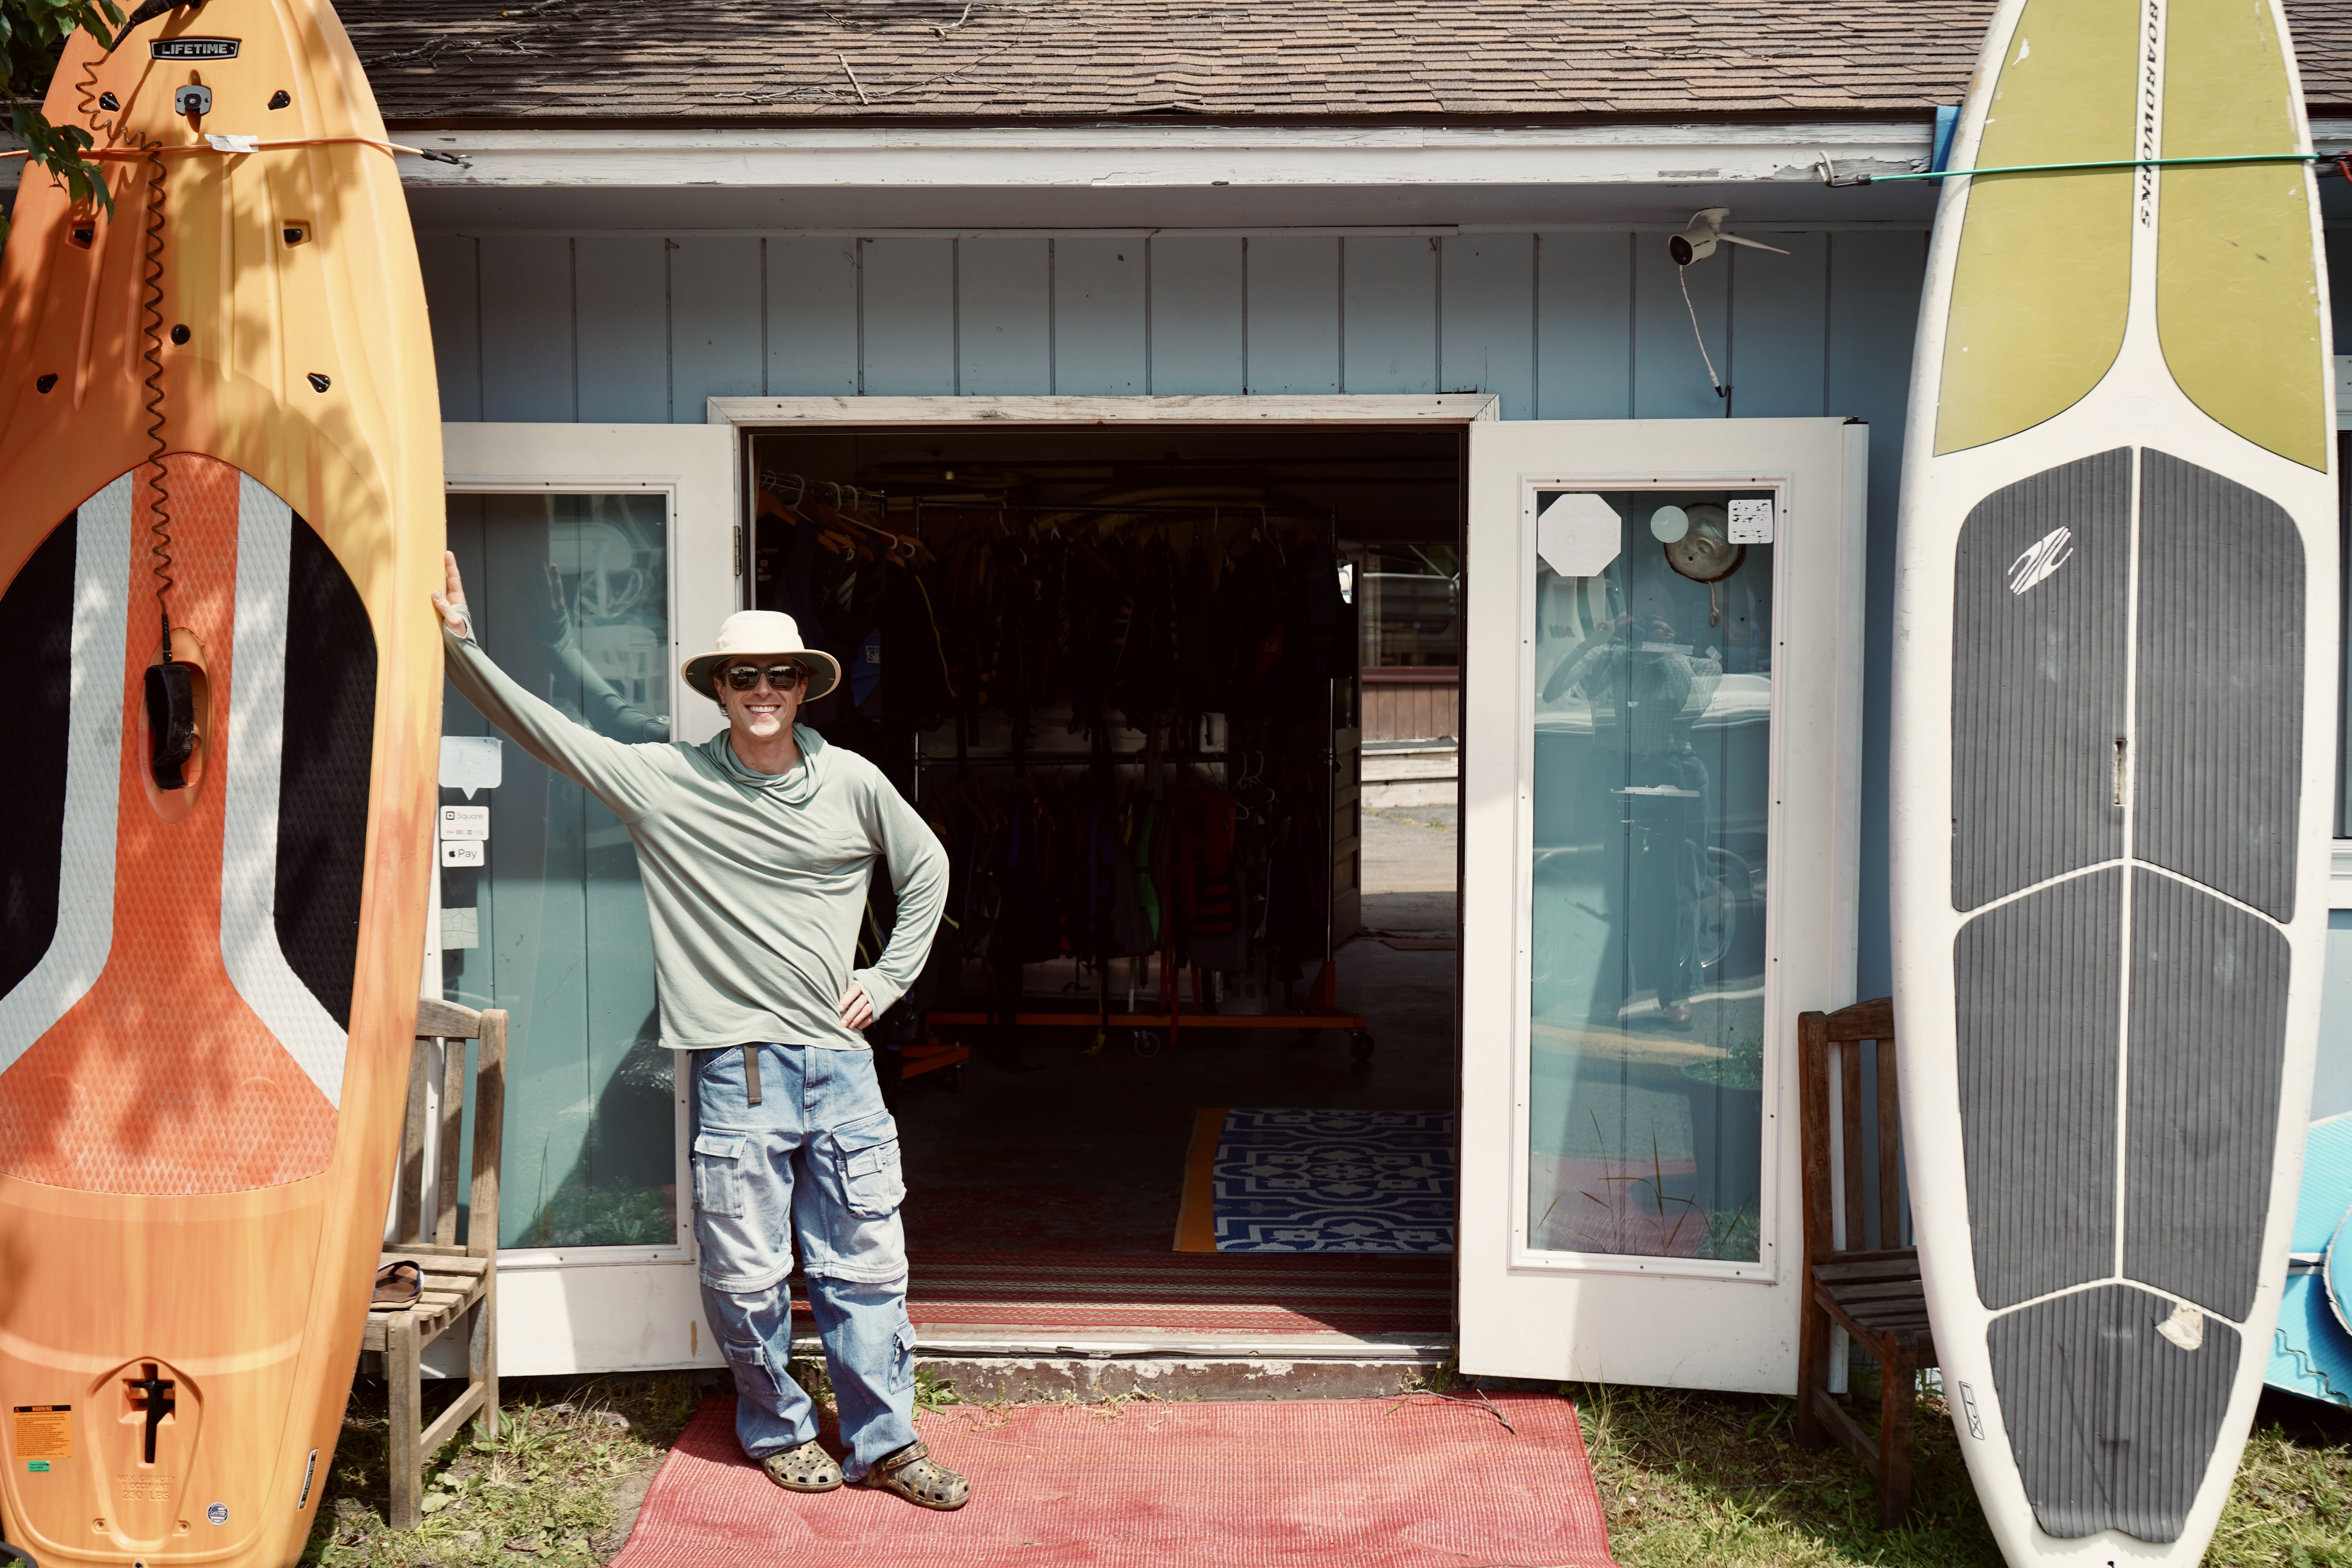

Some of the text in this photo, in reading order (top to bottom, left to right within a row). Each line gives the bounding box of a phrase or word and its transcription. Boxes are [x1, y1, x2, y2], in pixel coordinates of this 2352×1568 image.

[162, 44, 228, 54] LIFETIME
[2141, 0, 2158, 228] BOARDWORKS
[458, 849, 477, 860] Pay
[123, 1490, 170, 1500] 230 LBS
